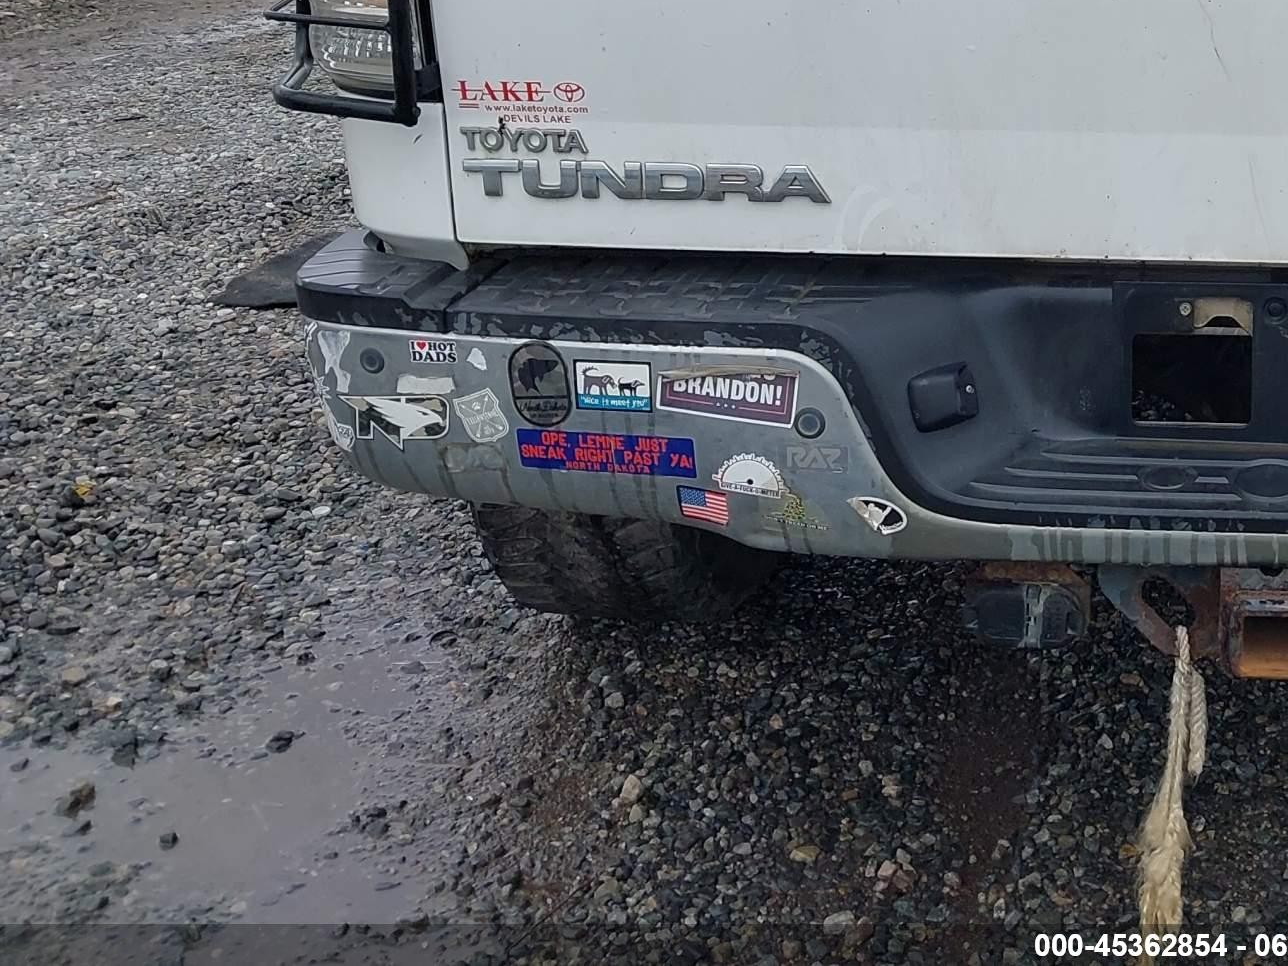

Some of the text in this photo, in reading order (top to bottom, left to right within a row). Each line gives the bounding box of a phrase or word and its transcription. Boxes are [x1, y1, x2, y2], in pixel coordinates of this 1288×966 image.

[457, 80, 544, 102] LAKE
[484, 104, 589, 115] www.laketoyota.com
[503, 114, 571, 123] DEVILS LAKE
[460, 126, 589, 153] TOYOTA
[462, 158, 832, 204] TUNDRA
[410, 341, 456, 351] I HOT
[411, 350, 457, 362] DADS
[579, 434, 625, 450] LEMME
[635, 438, 668, 453] JUST
[521, 444, 693, 469] SNEAK RIGHT PAST YA!
[566, 461, 650, 474] NORTH DAKOTA
